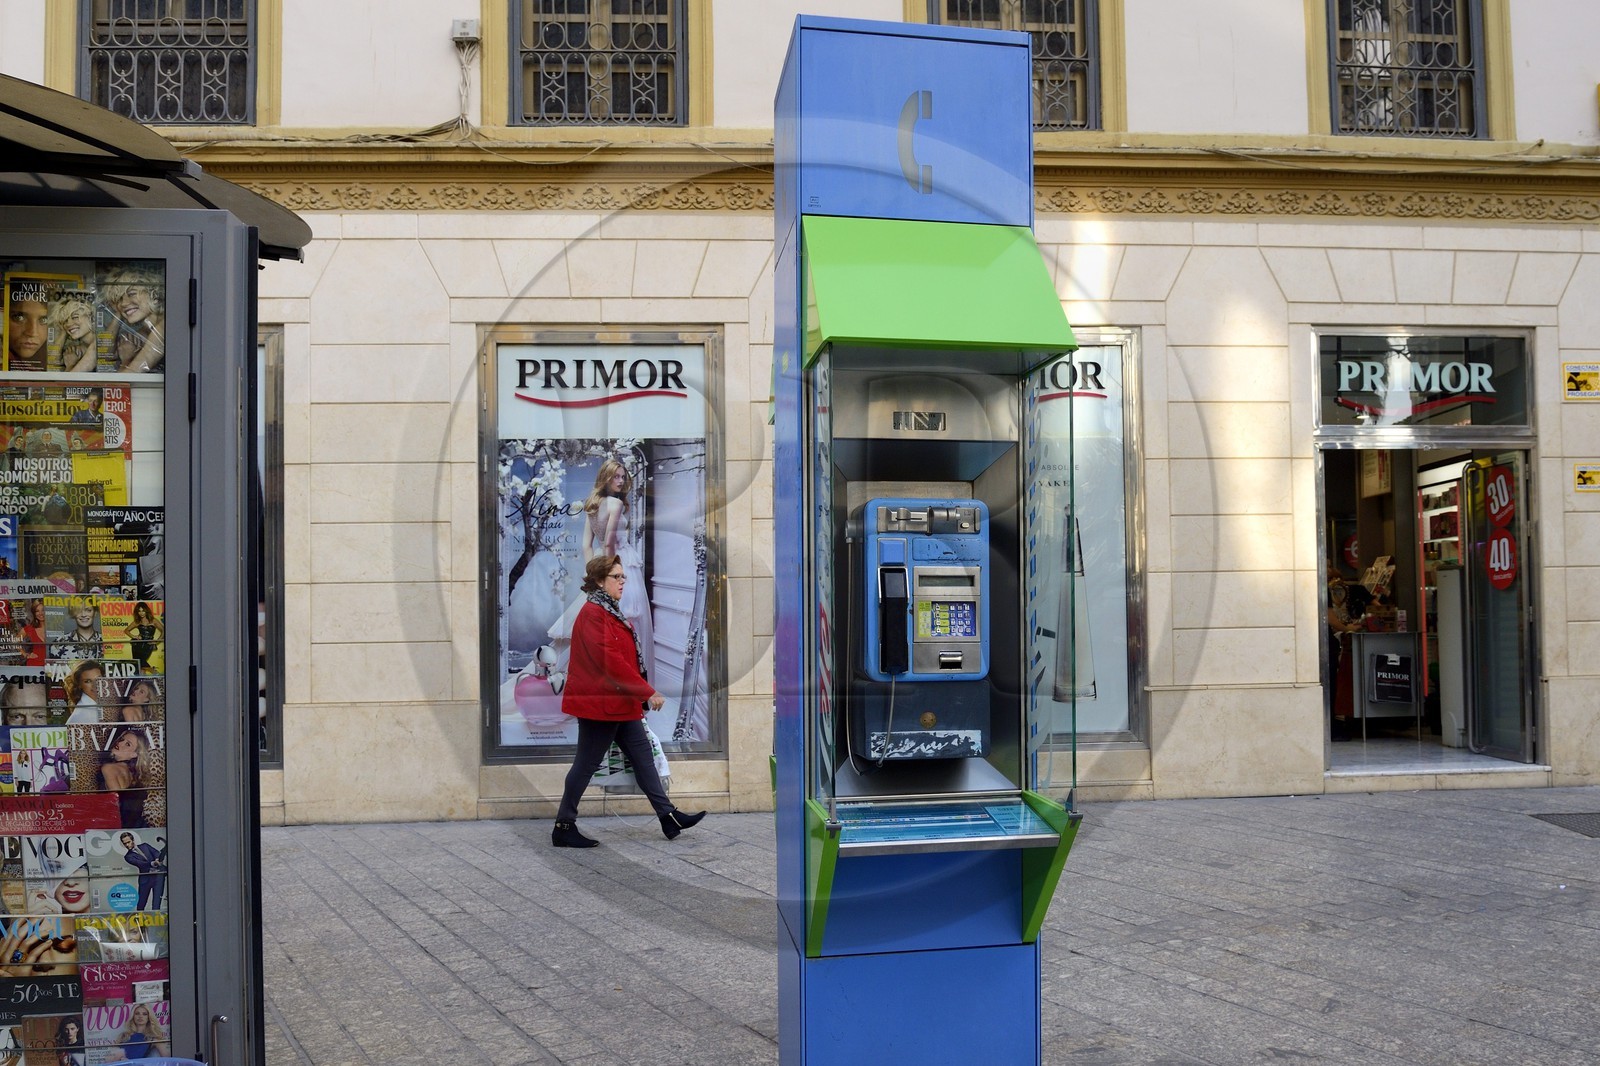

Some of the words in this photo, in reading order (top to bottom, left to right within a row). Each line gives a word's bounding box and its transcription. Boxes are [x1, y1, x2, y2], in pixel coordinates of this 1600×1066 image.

[515, 358, 689, 391] PRIMOR
[1337, 361, 1496, 393] PRIMOR
[505, 487, 584, 519] Nina
[39, 536, 85, 544] NATIONAL
[87, 540, 139, 552] CONSPIRACIONES
[545, 535, 577, 544] RICCI
[37, 555, 55, 565] 125
[17, 585, 58, 595] GLAMOUR
[44, 594, 86, 607] marie
[104, 663, 136, 678] FAIR
[1377, 671, 1410, 681] PRIMOR
[47, 808, 64, 821] 25
[26, 835, 85, 859] VOG
